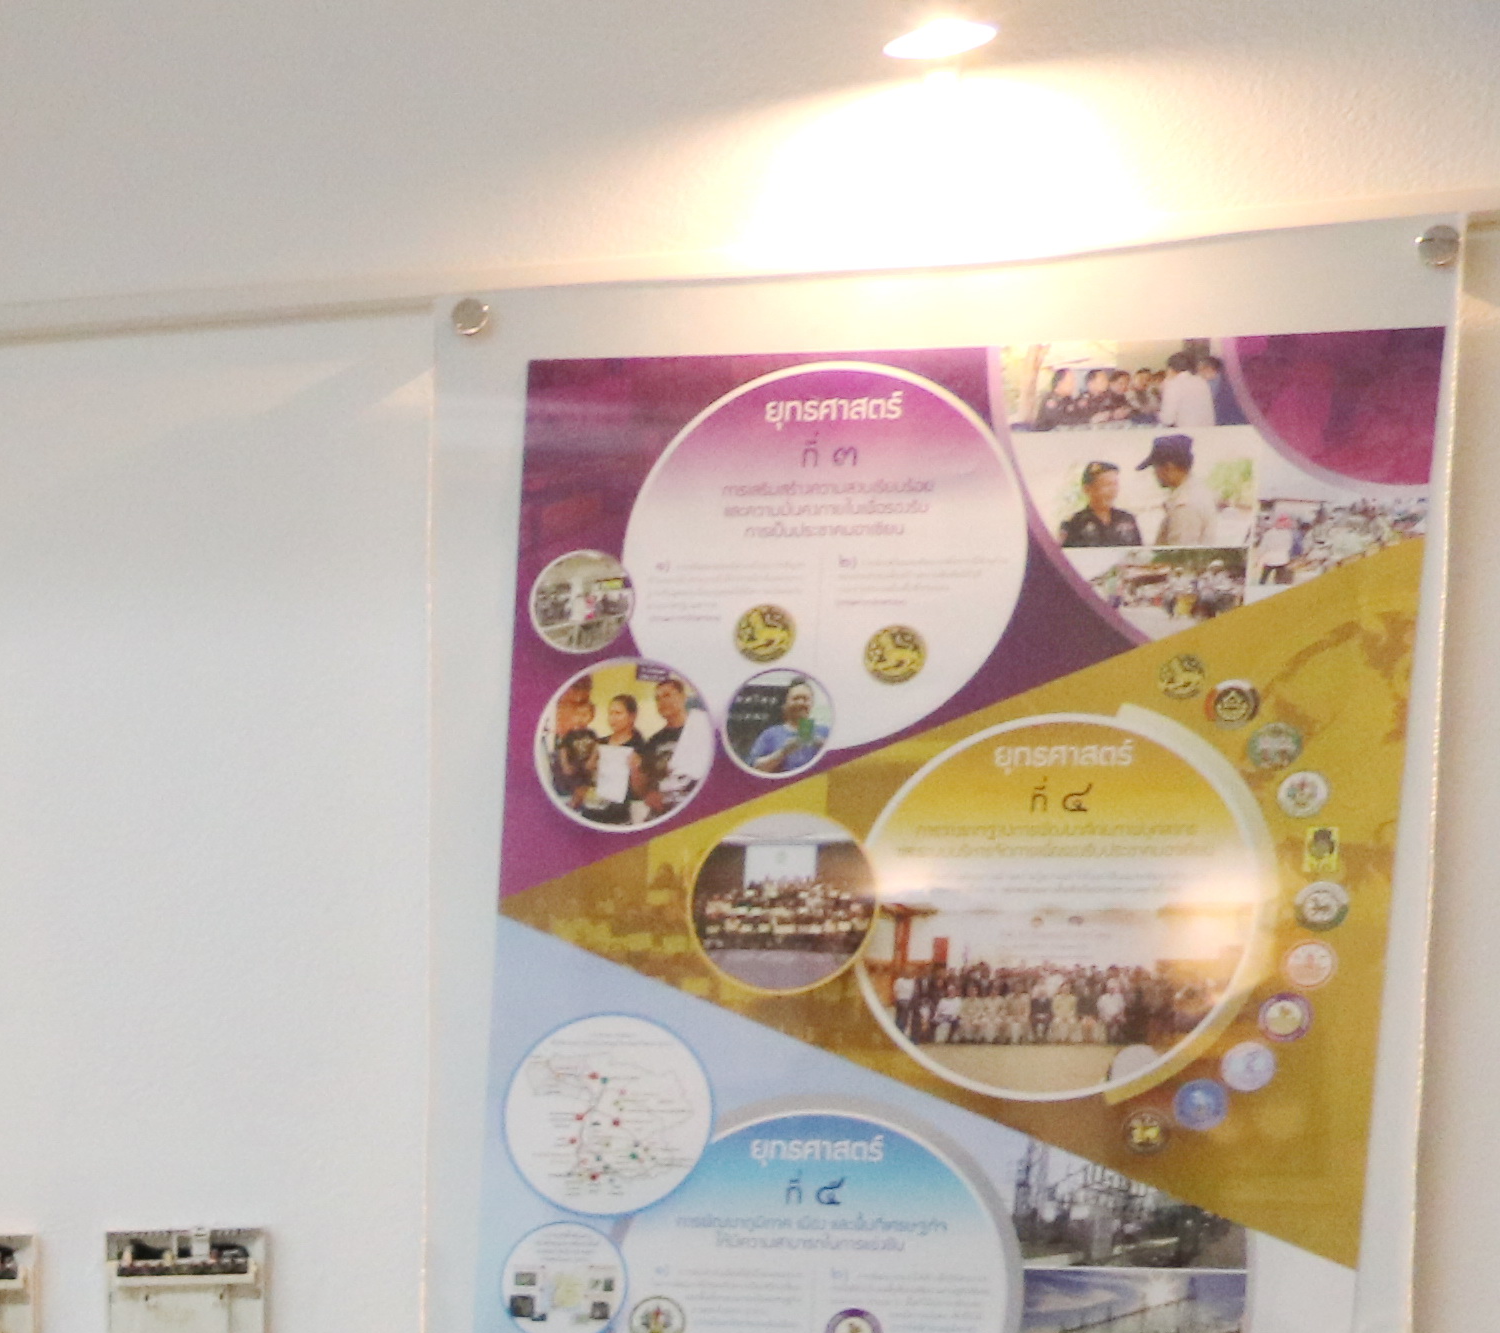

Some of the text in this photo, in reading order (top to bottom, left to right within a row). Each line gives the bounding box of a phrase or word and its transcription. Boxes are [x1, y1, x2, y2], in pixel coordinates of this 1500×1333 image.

[764, 390, 904, 431] ยุทธศาสตร์
[832, 446, 858, 466] ๓
[993, 739, 1136, 776] ยุทธศาสตร์
[1061, 783, 1094, 813] ๔
[751, 1134, 885, 1167] ยุทธศาสตร์
